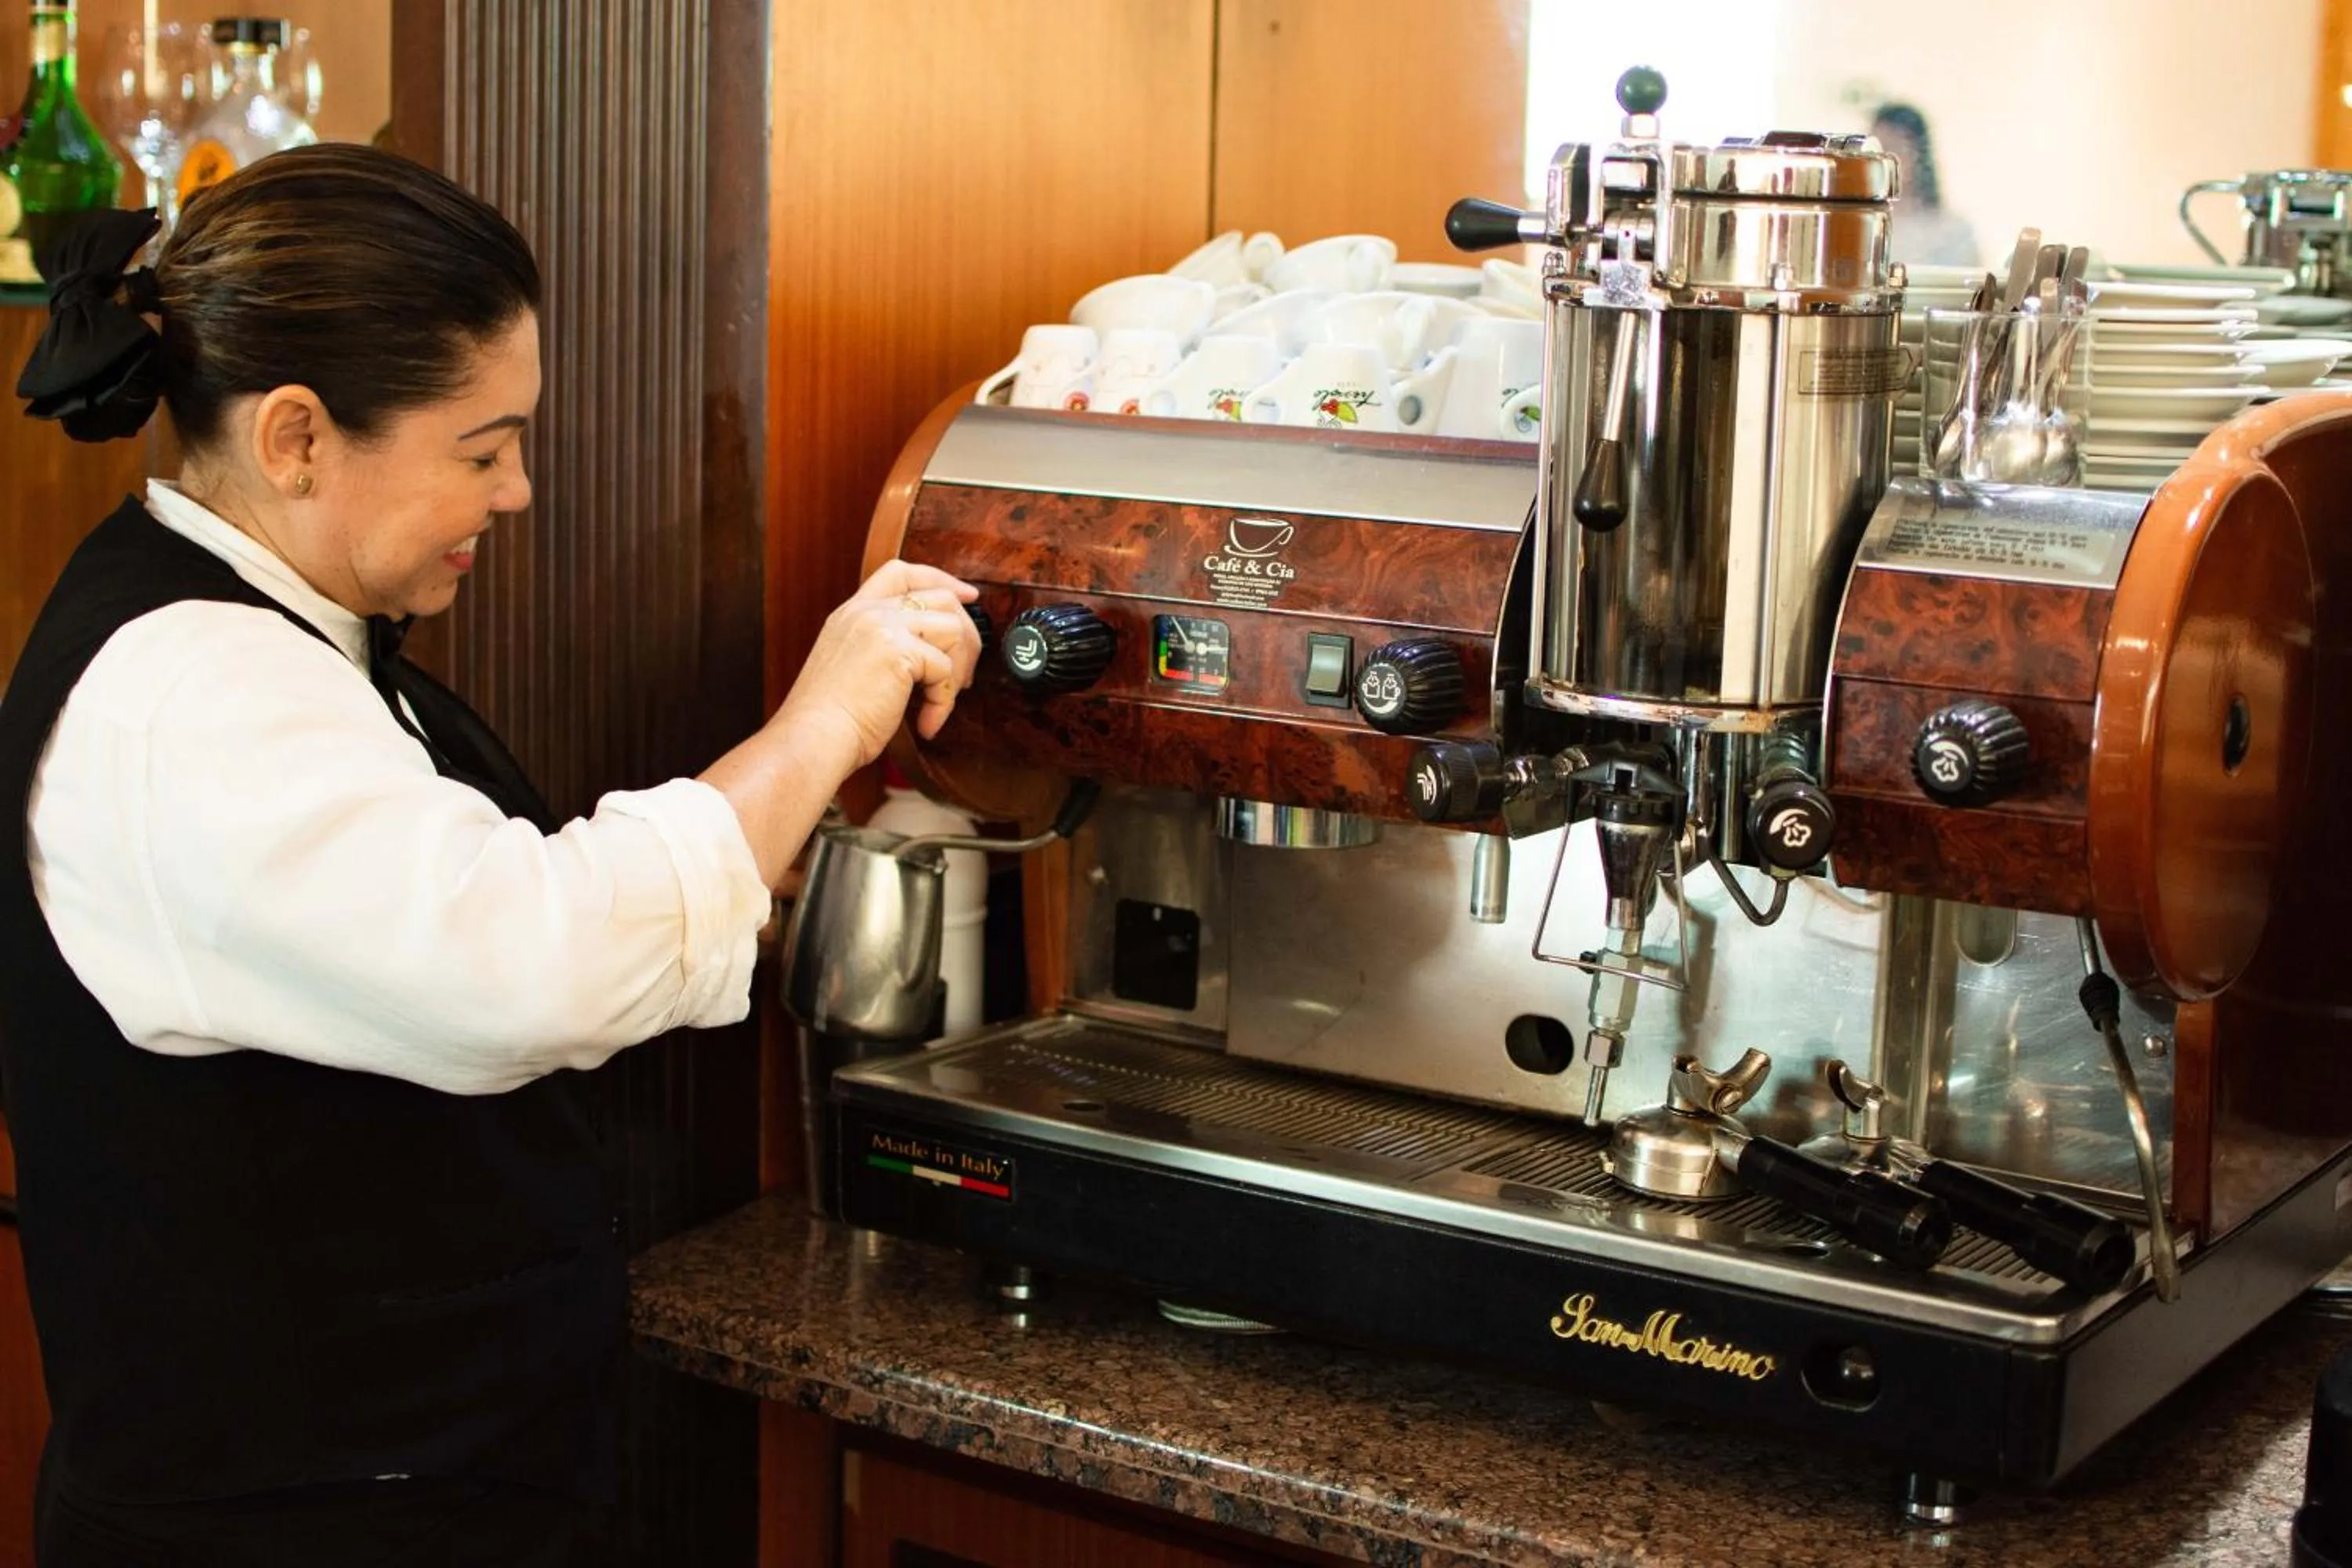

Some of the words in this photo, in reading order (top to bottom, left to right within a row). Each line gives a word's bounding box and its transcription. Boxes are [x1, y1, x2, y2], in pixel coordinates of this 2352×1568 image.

[1203, 555, 1241, 573] Café
[1244, 560, 1261, 575] &
[1266, 562, 1295, 579] Cia
[872, 1134, 928, 1159] Made
[935, 1147, 953, 1166] in
[962, 1153, 1004, 1180] Italy
